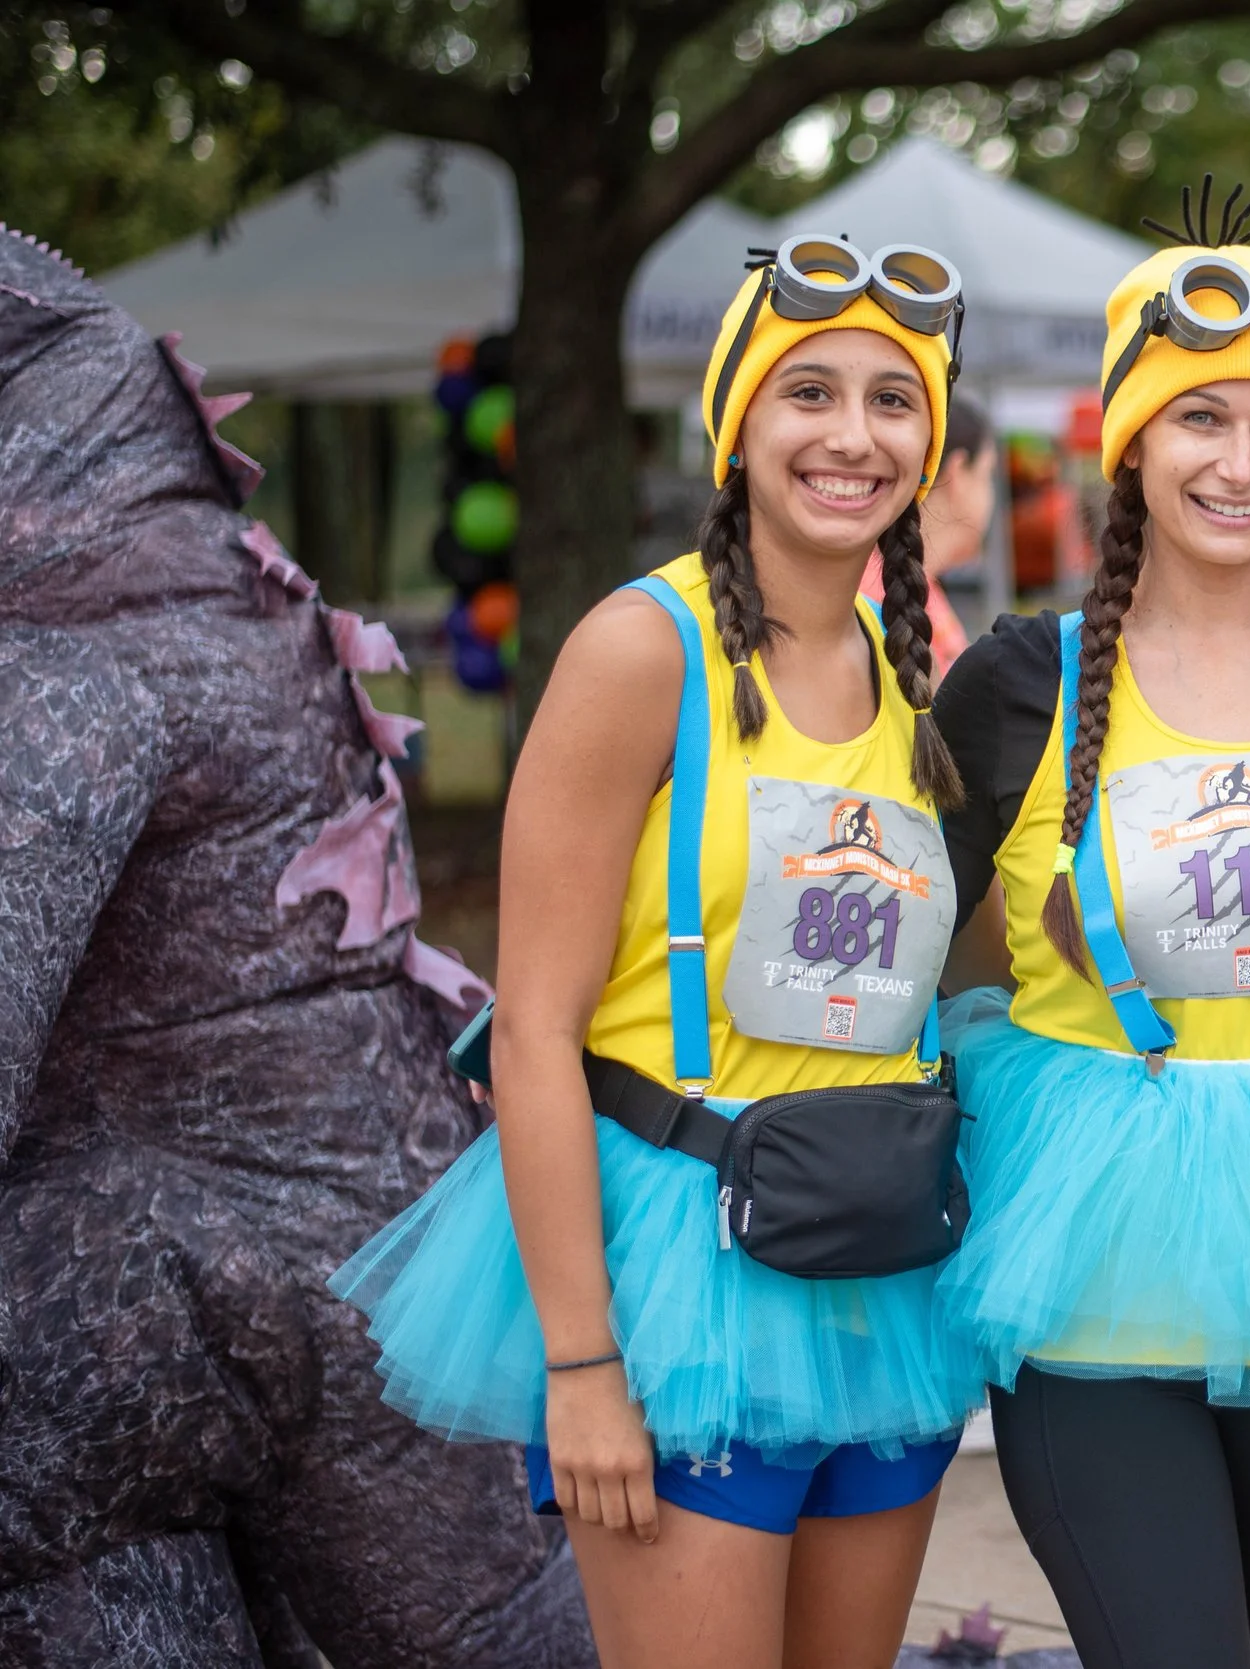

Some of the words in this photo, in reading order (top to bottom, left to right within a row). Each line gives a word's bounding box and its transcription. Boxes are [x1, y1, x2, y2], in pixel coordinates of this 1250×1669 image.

[793, 887, 901, 969] 881
[1184, 923, 1239, 939] TRINITY
[1184, 937, 1227, 952] FALLS
[789, 964, 838, 981] TRINITY
[786, 977, 824, 992] FALLS
[854, 974, 914, 997] TEXANS
[743, 1200, 753, 1232] lululemon
